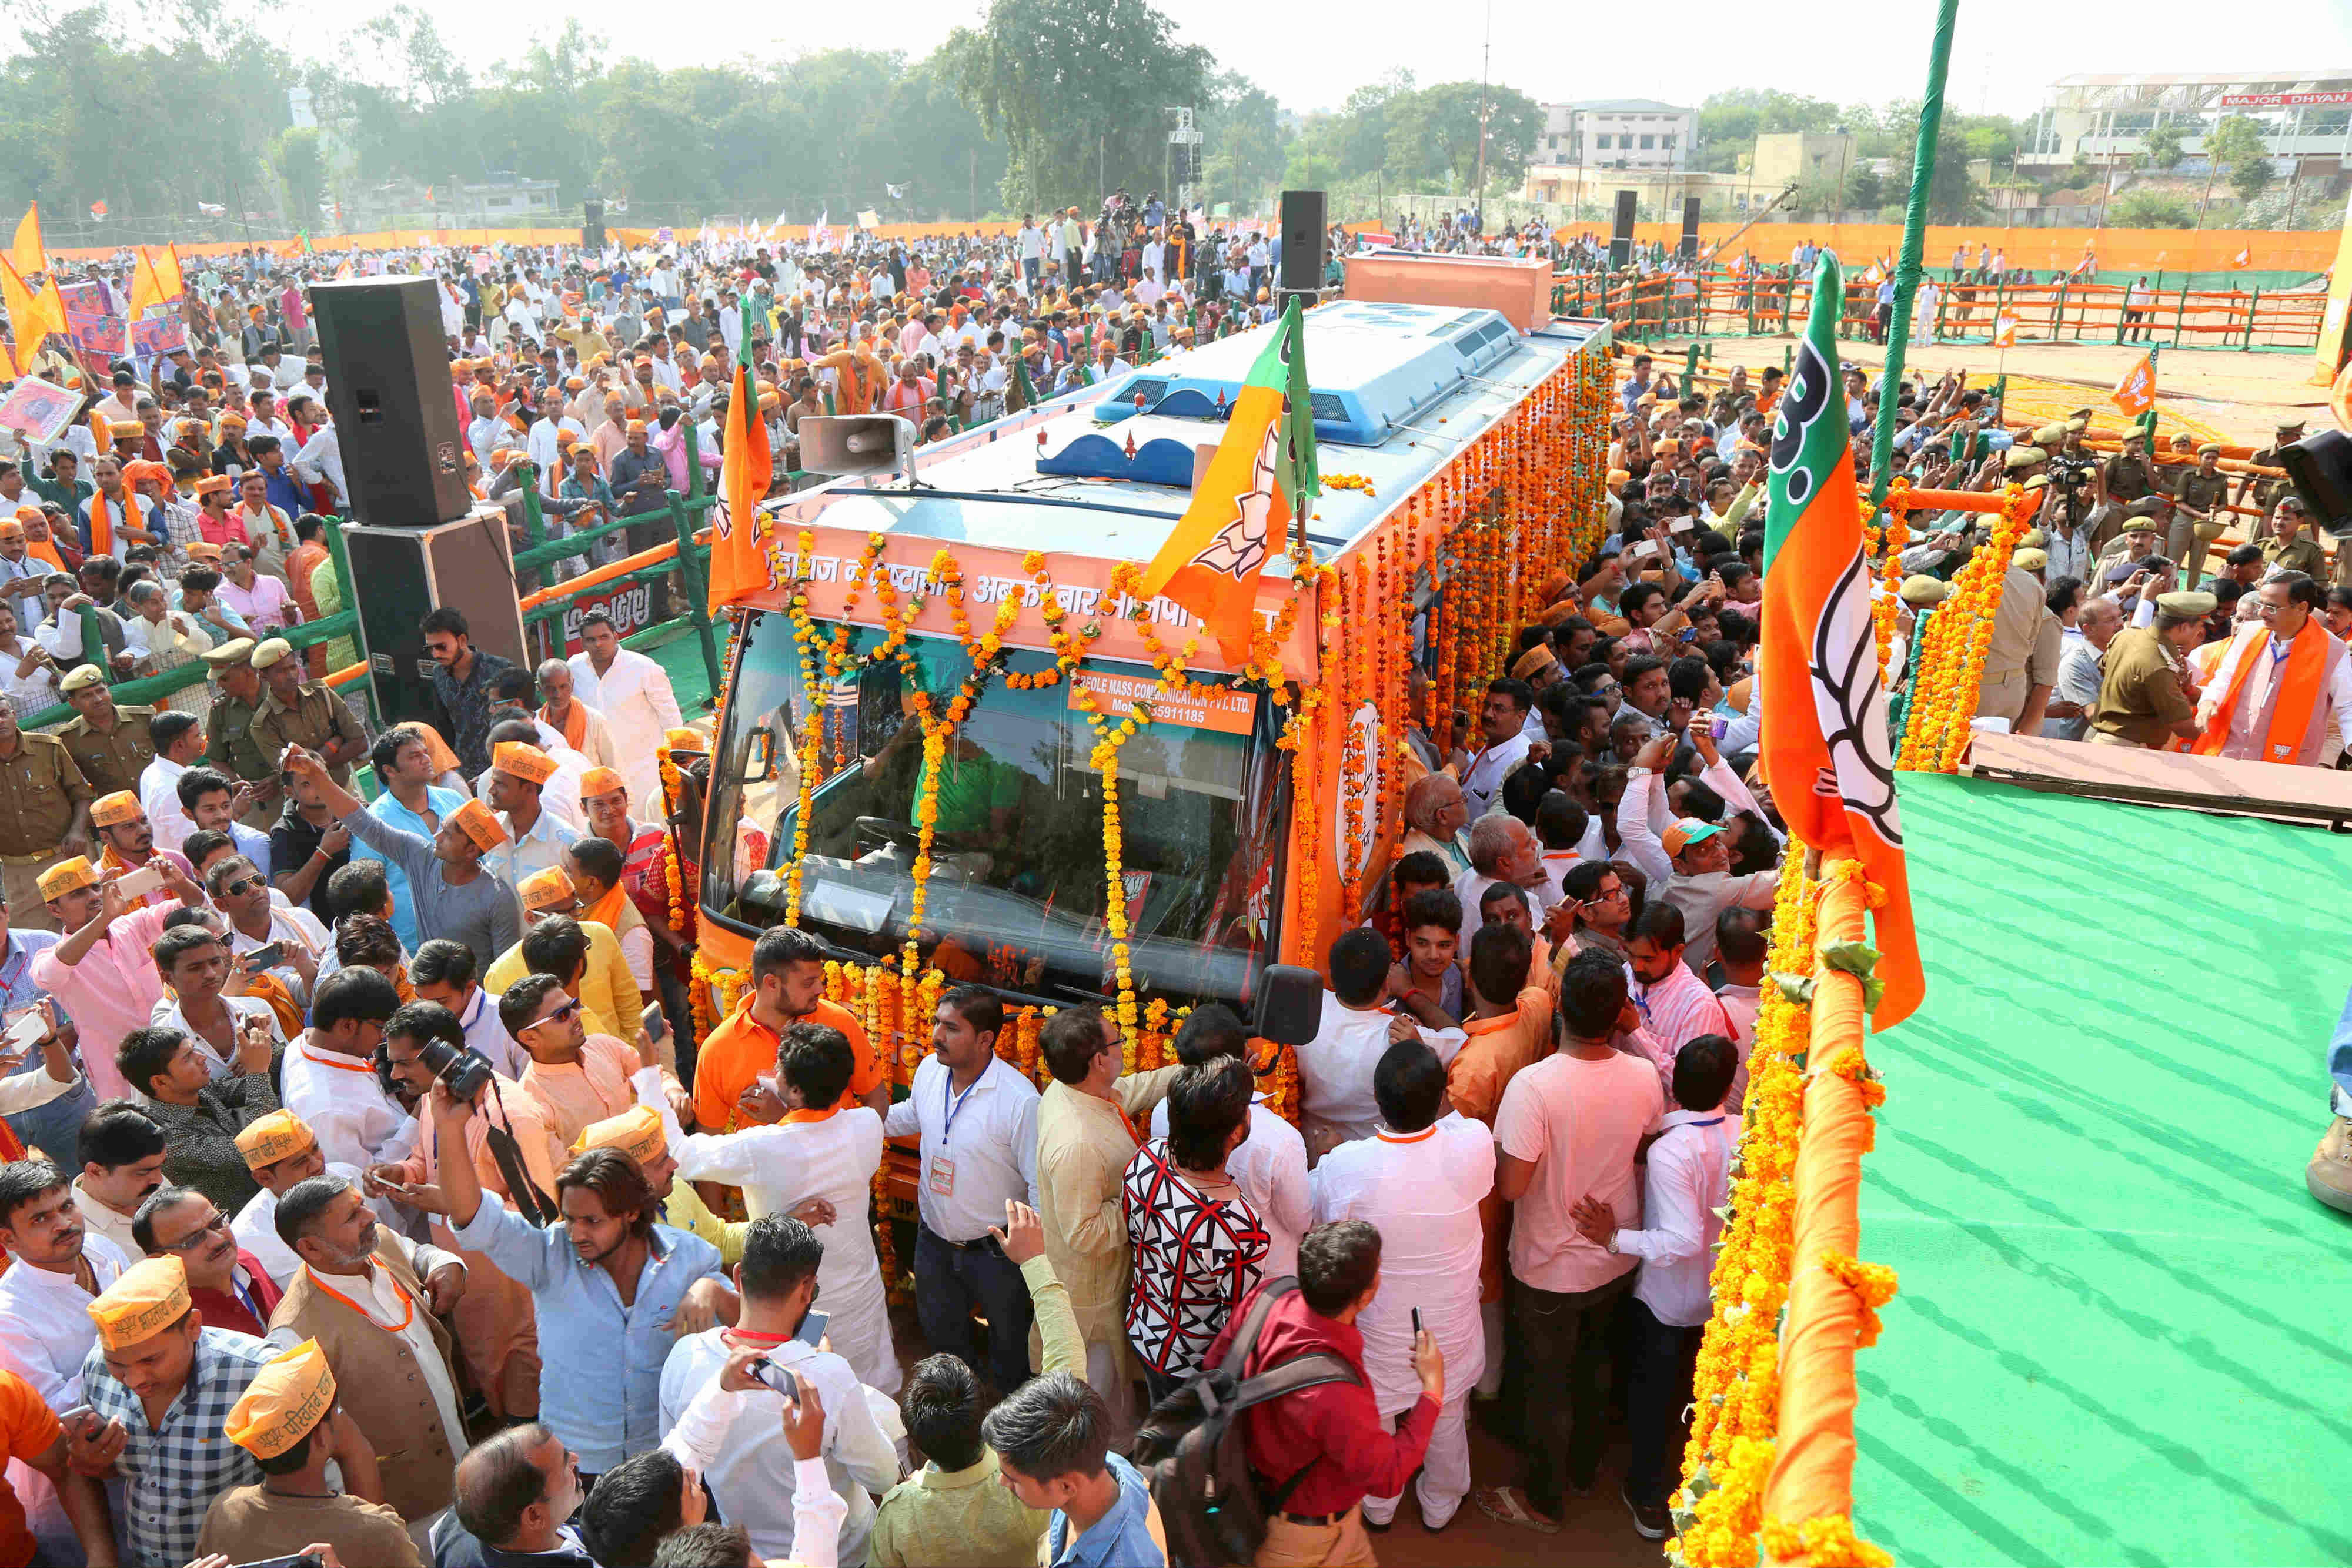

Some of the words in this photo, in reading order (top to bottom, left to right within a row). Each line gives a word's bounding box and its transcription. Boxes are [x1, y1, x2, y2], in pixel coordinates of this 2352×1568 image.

[2226, 96, 2282, 105] MAJOR
[2291, 93, 2347, 103] DHYAN
[1056, 584, 1102, 616] बार
[1108, 679, 1133, 697] MASS
[1231, 696, 1251, 714] LTD.
[283, 1391, 324, 1435] परिवर्तन
